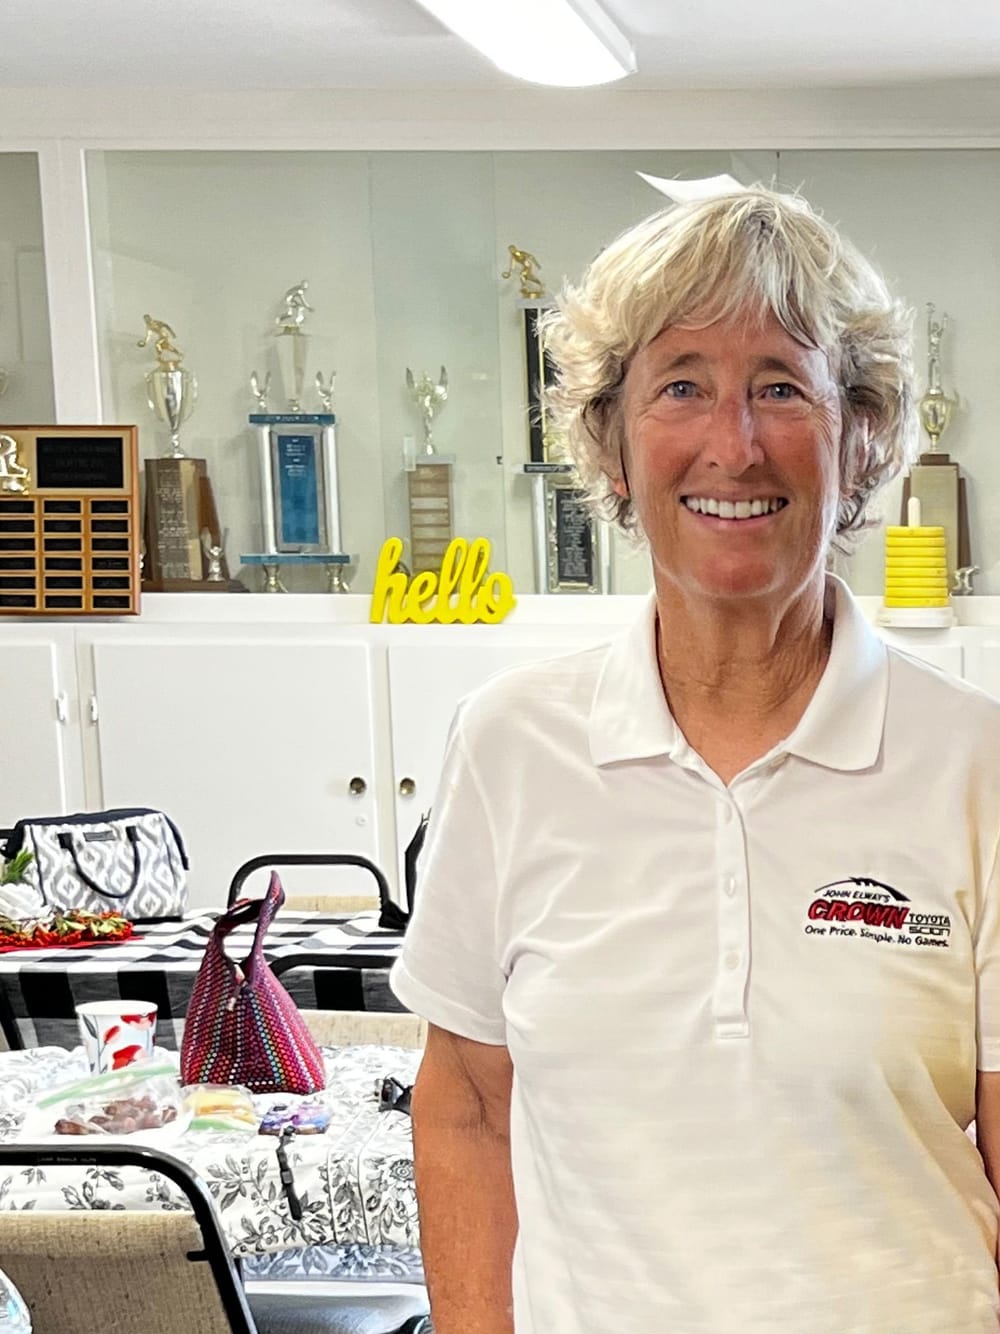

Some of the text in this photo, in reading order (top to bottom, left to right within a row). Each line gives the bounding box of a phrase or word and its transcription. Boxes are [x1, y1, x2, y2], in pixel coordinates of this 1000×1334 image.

[370, 536, 518, 624] hello
[823, 889, 891, 903] JOHN ELWAY'S
[808, 899, 910, 929] CROWN
[909, 912, 951, 926] TOYOTA
[805, 924, 950, 948] One Price. Simple. No Games.
